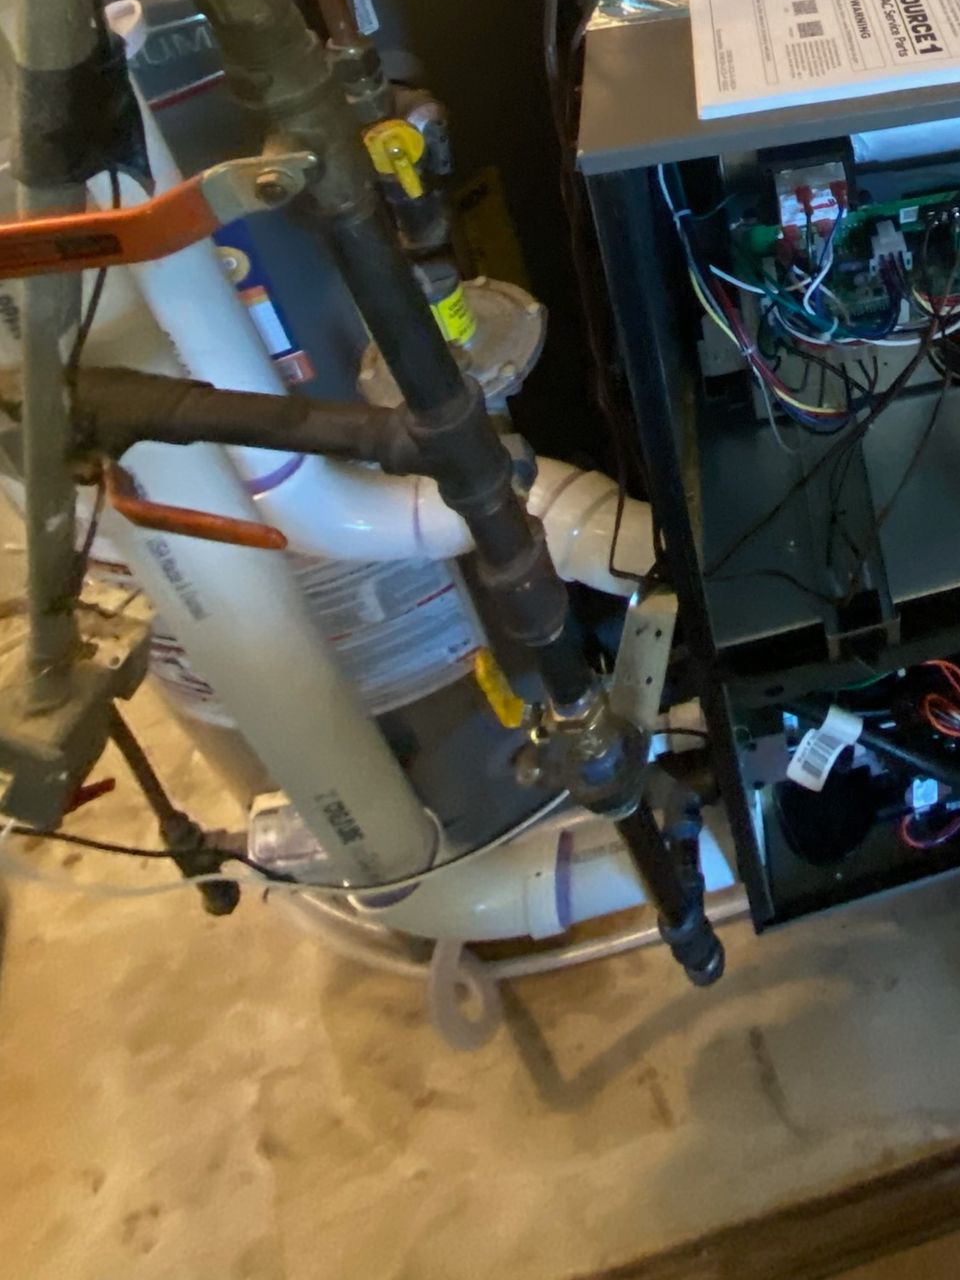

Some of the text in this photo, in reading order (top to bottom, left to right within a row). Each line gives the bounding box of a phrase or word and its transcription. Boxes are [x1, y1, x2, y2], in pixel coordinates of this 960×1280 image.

[848, 0, 872, 39] WARNING
[884, 9, 901, 36] Service
[895, 36, 909, 58] Parts
